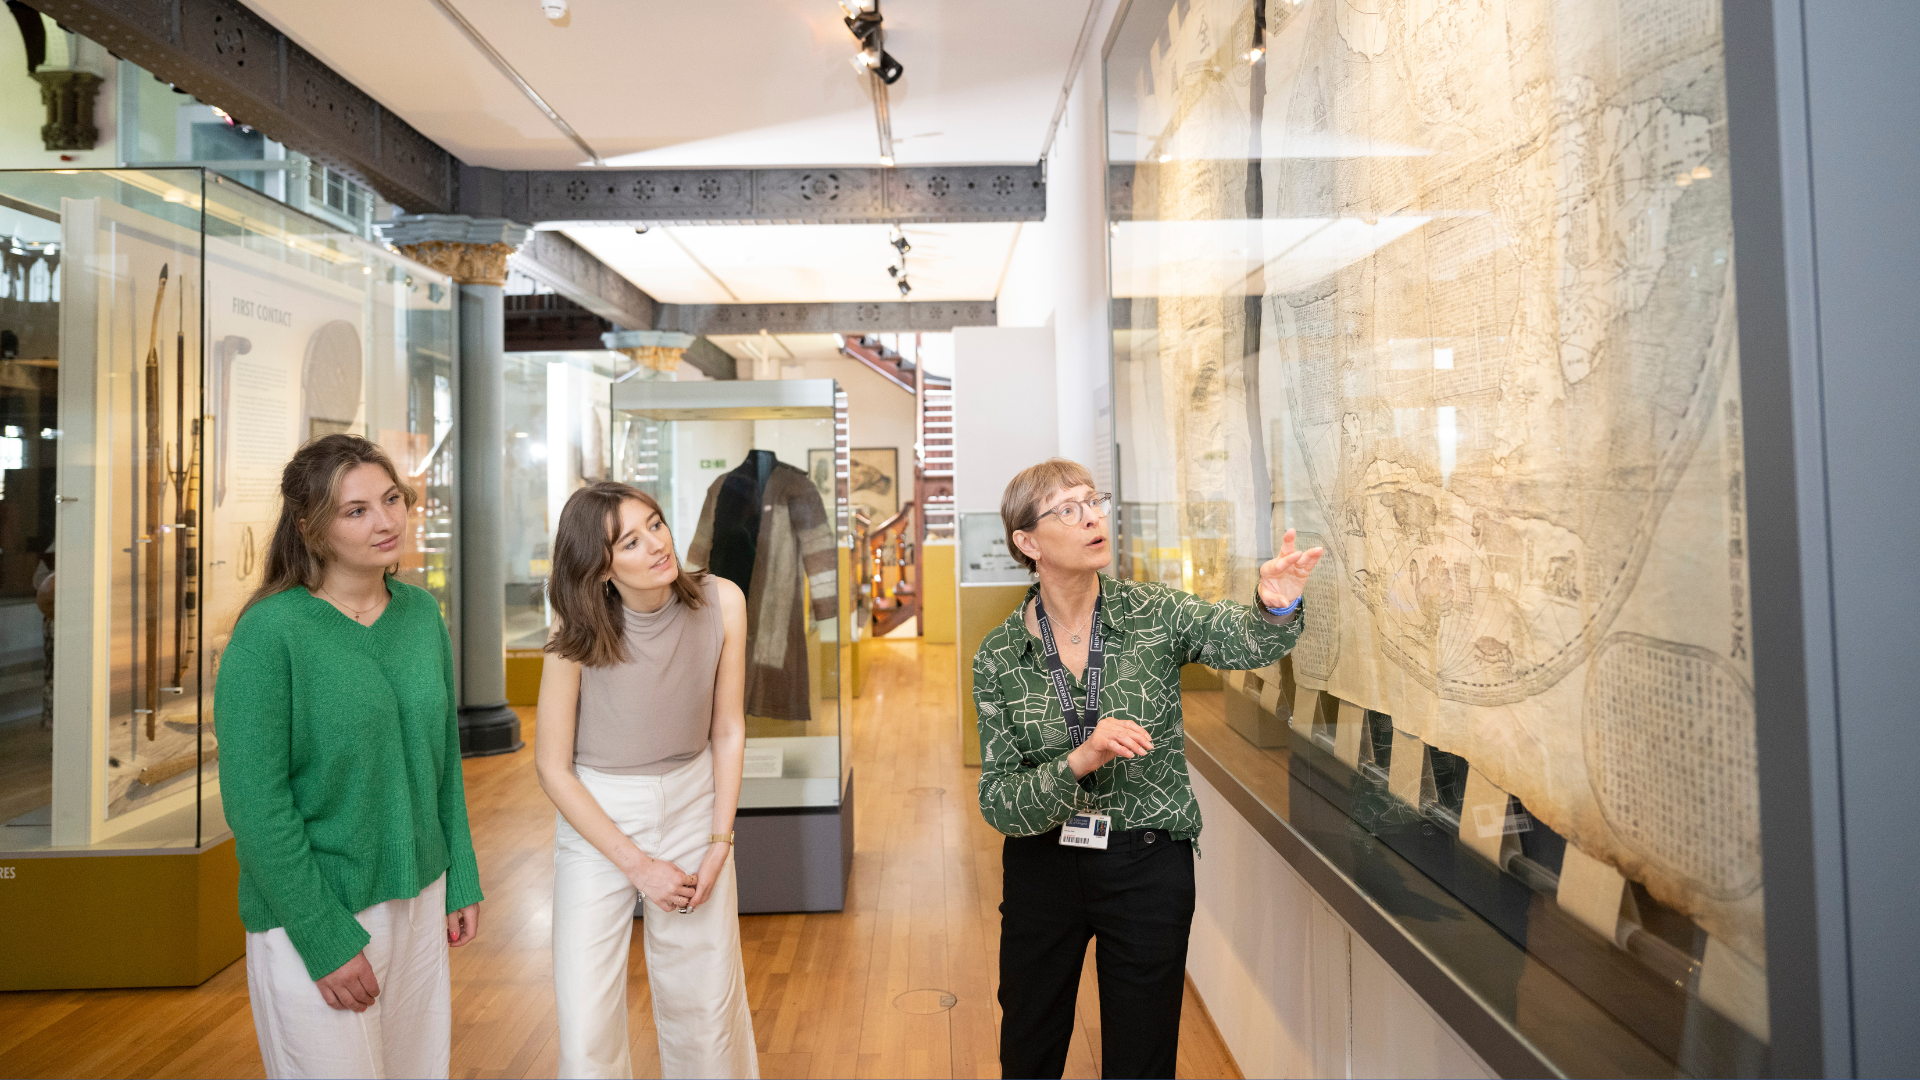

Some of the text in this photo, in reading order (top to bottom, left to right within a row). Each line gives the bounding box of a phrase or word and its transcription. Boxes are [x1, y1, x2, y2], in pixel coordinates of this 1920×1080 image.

[233, 297, 291, 328] FIRST CONTACT
[1055, 673, 1070, 707] HUNTERIAN
[1090, 671, 1098, 707] HUNTERIAN
